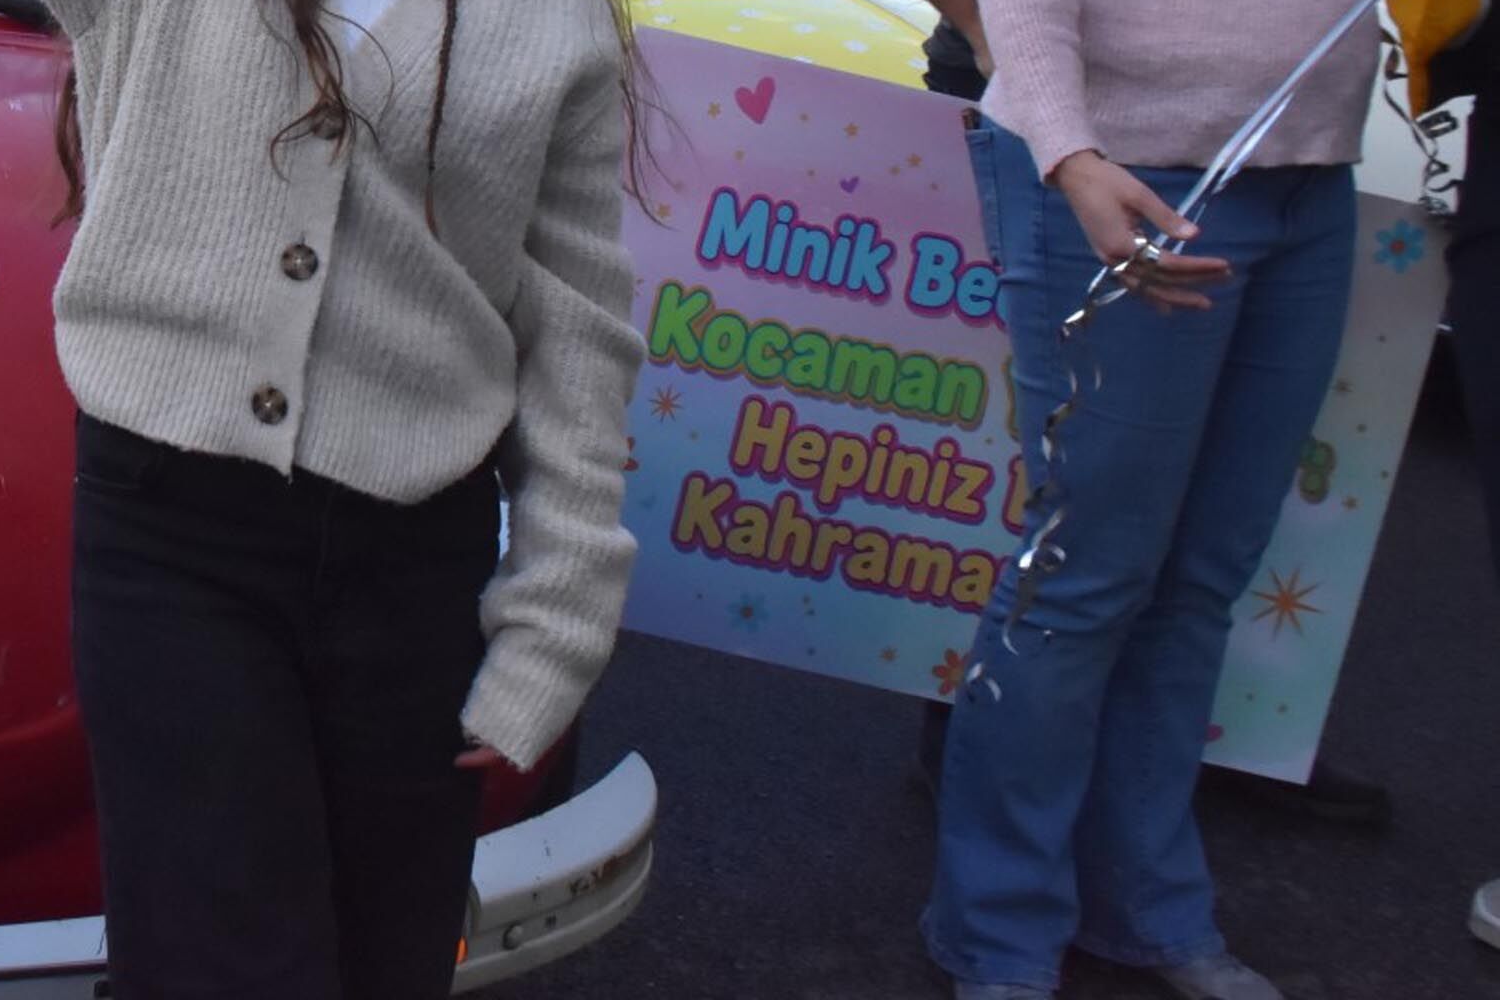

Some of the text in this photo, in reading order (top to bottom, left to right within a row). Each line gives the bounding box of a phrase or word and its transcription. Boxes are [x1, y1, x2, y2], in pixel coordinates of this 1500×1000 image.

[698, 188, 1008, 326] Minik Be
[649, 282, 987, 425] Kocaman
[730, 400, 992, 521] Hepiniz
[672, 475, 1005, 612] Kahrama
